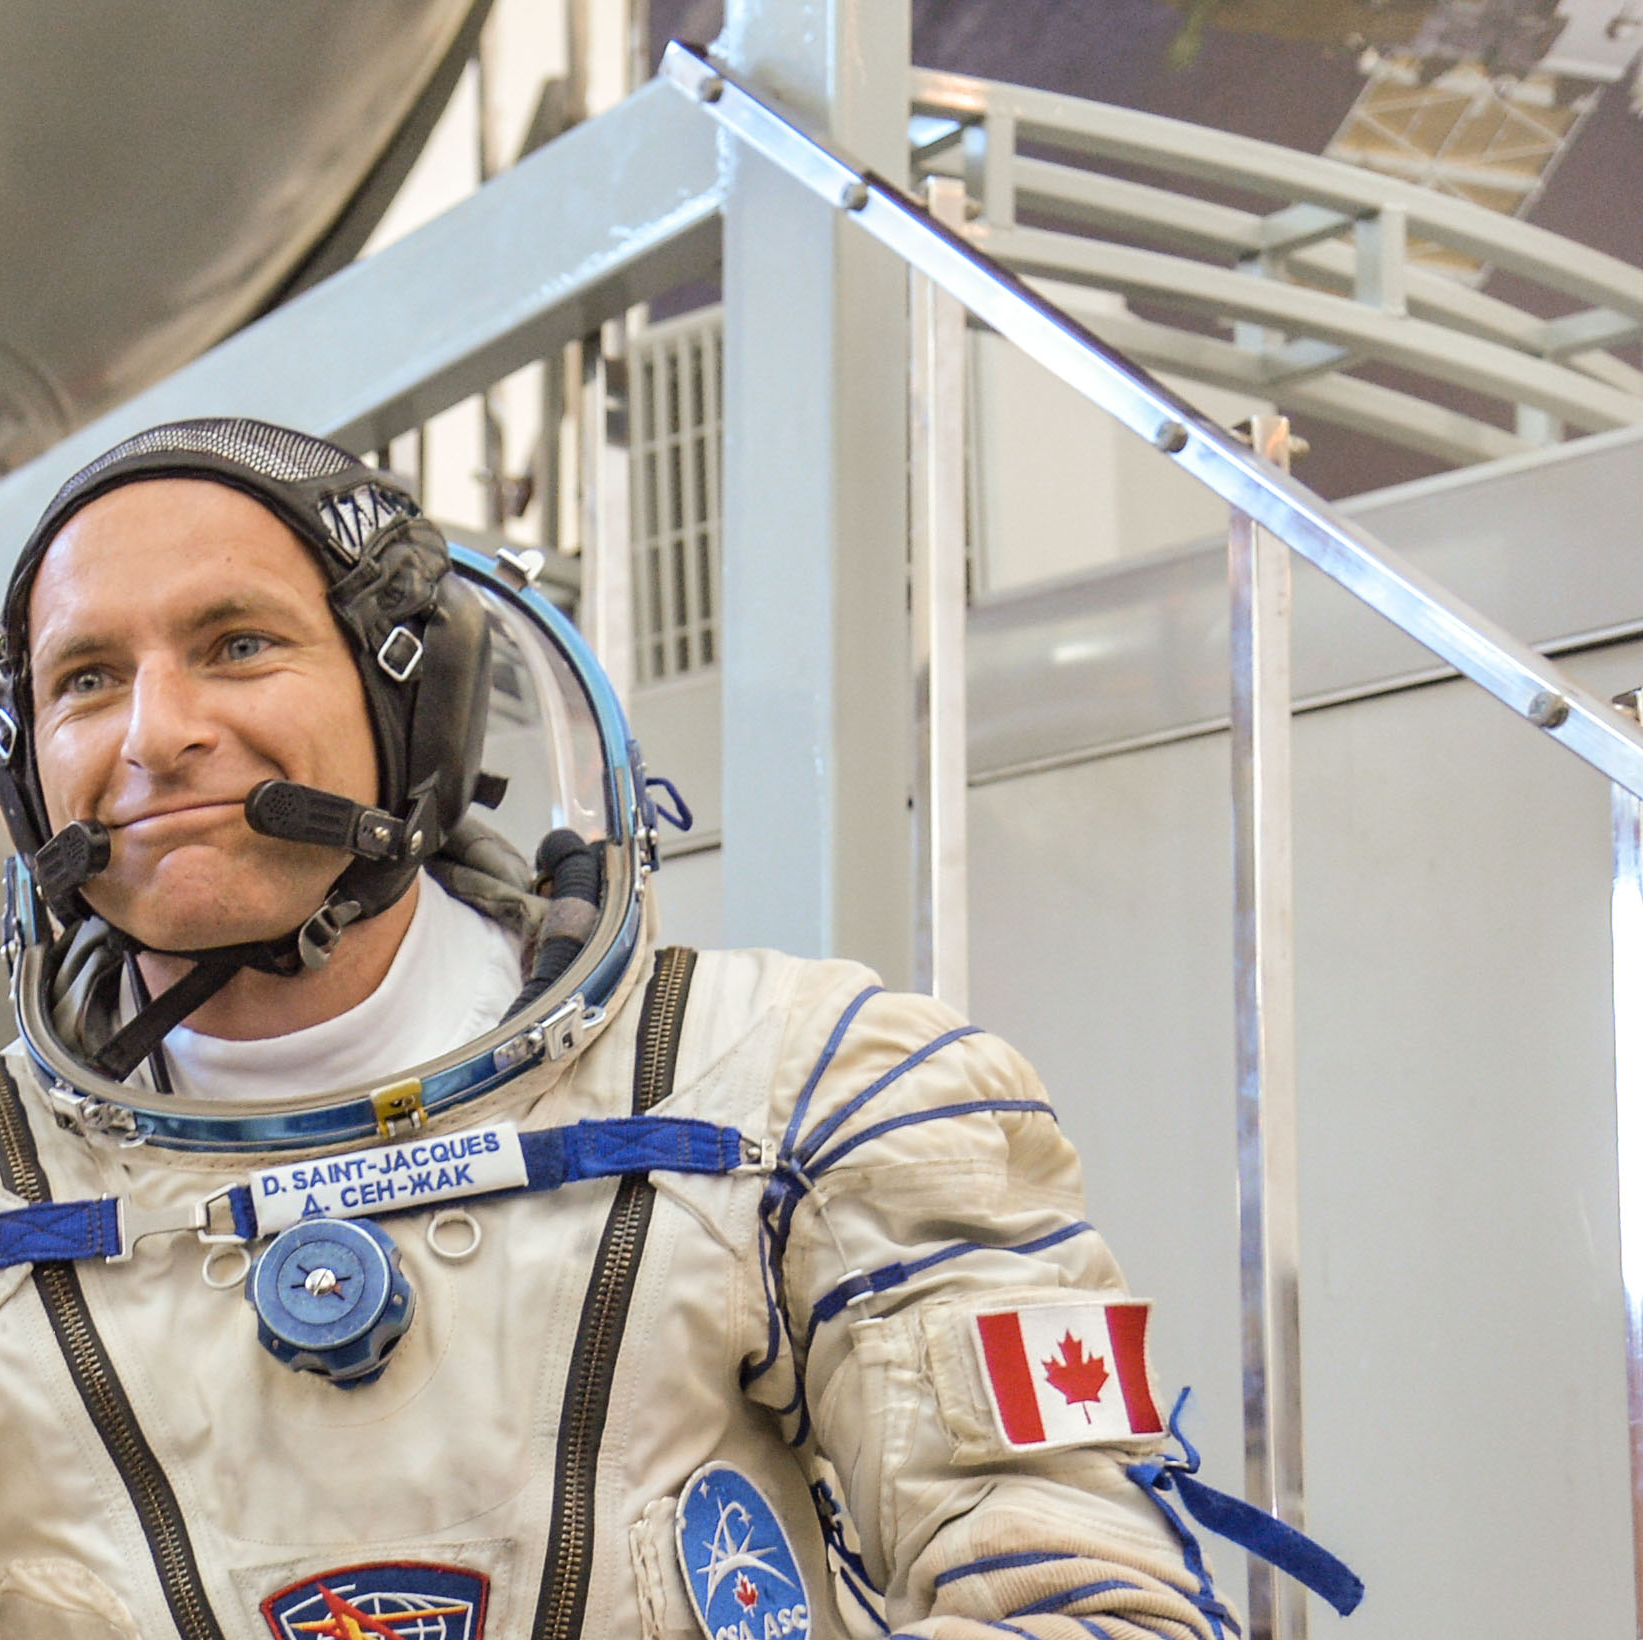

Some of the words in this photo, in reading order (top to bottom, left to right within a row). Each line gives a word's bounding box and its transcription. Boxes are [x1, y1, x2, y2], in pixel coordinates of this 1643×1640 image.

[261, 1175, 287, 1197] D.
[292, 1131, 500, 1191] SAINT-JACQUES
[340, 1163, 475, 1207] СЕН-ЖАК
[763, 1604, 811, 1640] ASC
